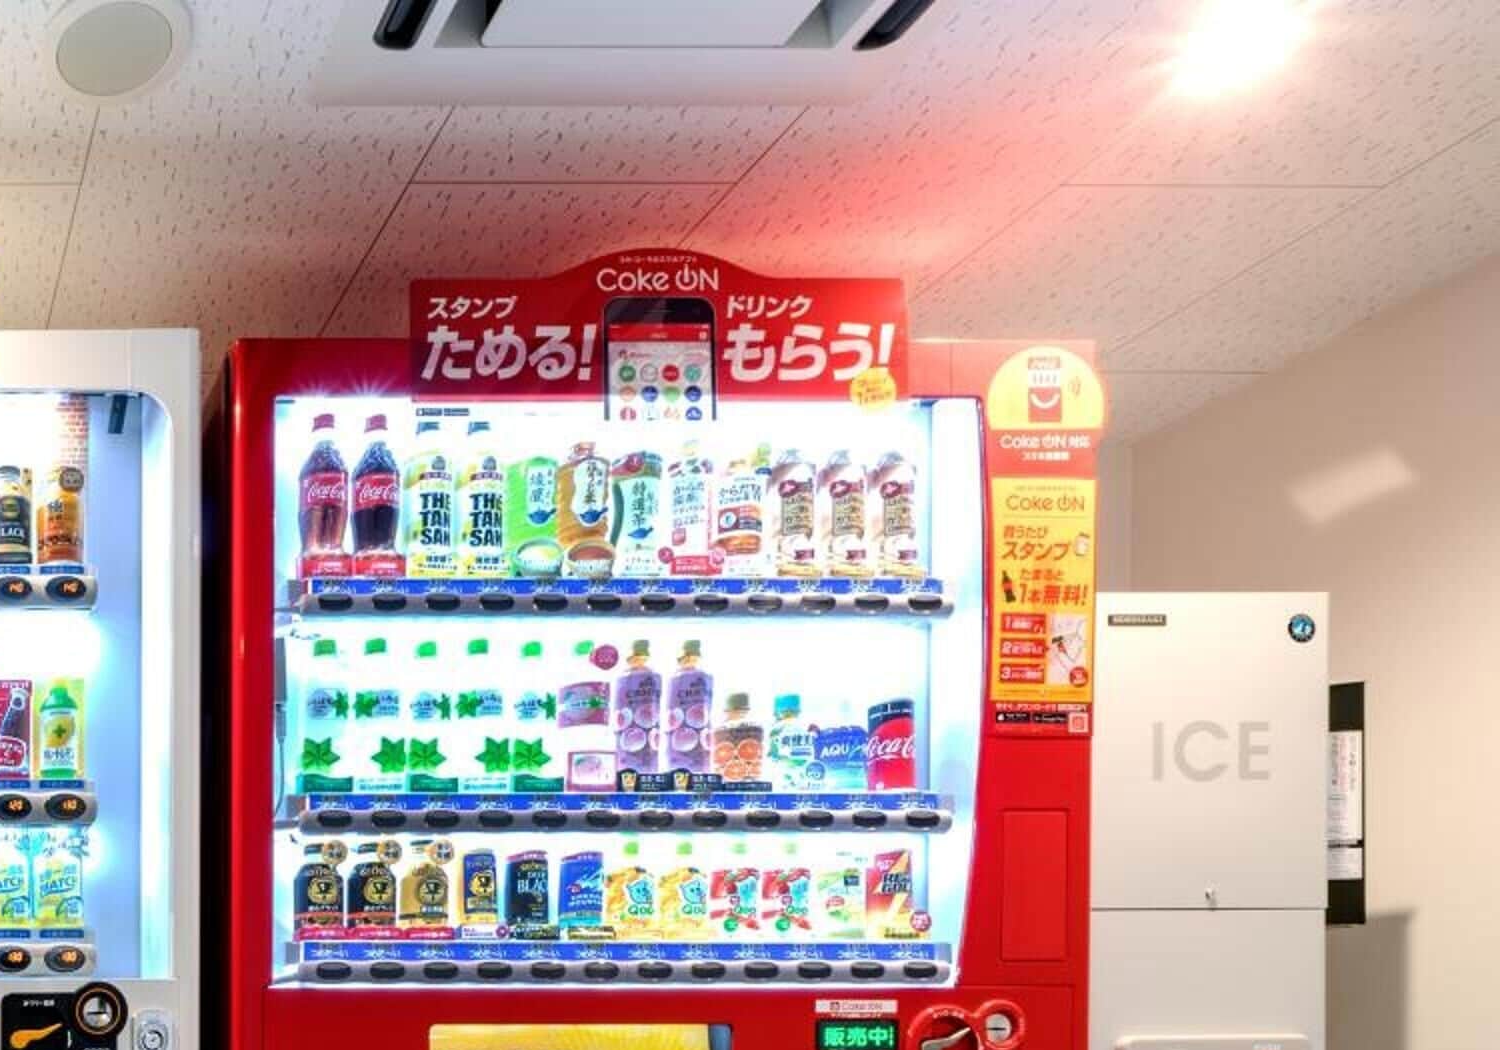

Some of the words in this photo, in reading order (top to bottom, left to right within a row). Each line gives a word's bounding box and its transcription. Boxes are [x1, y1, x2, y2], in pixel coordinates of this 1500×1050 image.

[597, 267, 669, 291] Coke
[678, 264, 719, 291] ON
[427, 295, 518, 319] スタンプ
[726, 295, 812, 318] ドリンク
[1005, 495, 1053, 511] Coke
[1057, 494, 1085, 512] ON
[1001, 540, 1070, 560] スタンプ
[1152, 719, 1271, 783] ICE
